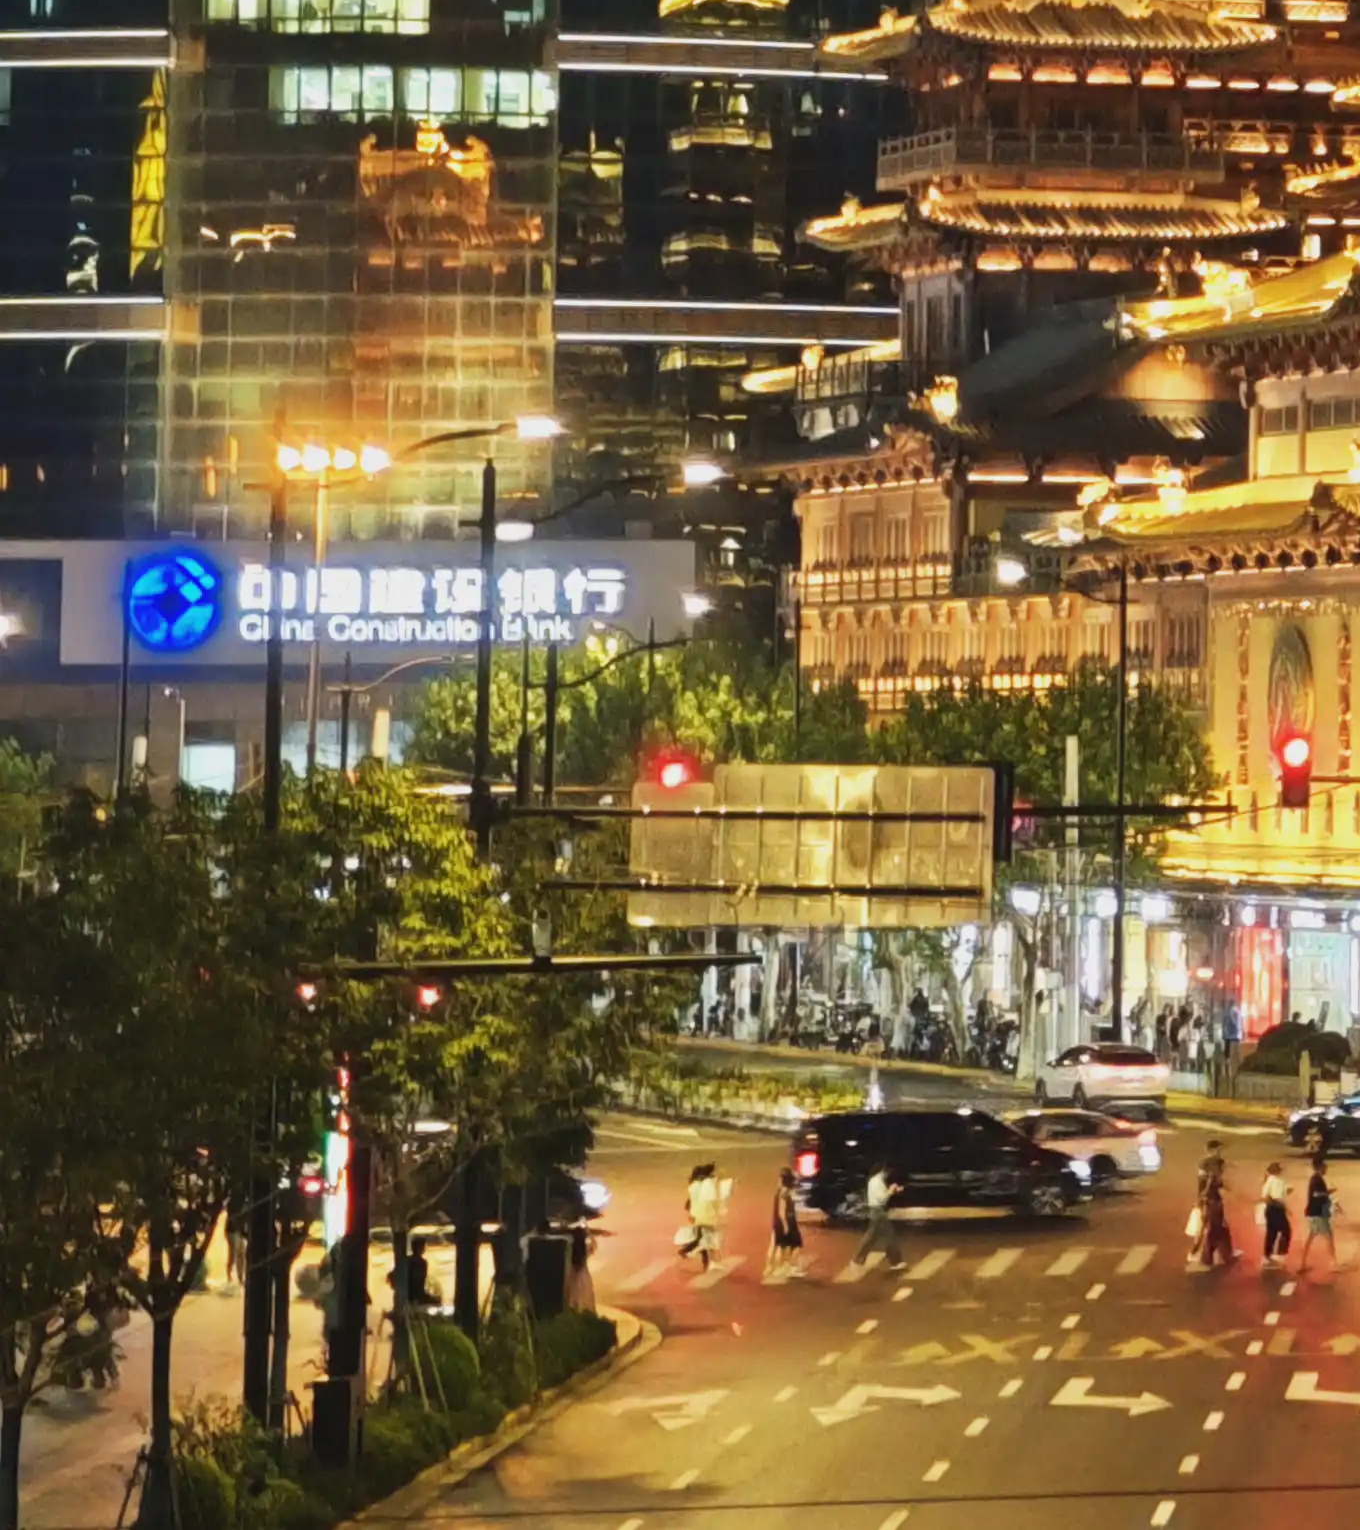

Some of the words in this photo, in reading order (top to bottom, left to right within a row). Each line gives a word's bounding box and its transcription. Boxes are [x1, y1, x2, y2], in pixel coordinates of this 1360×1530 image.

[239, 563, 627, 614] 中国建设银行
